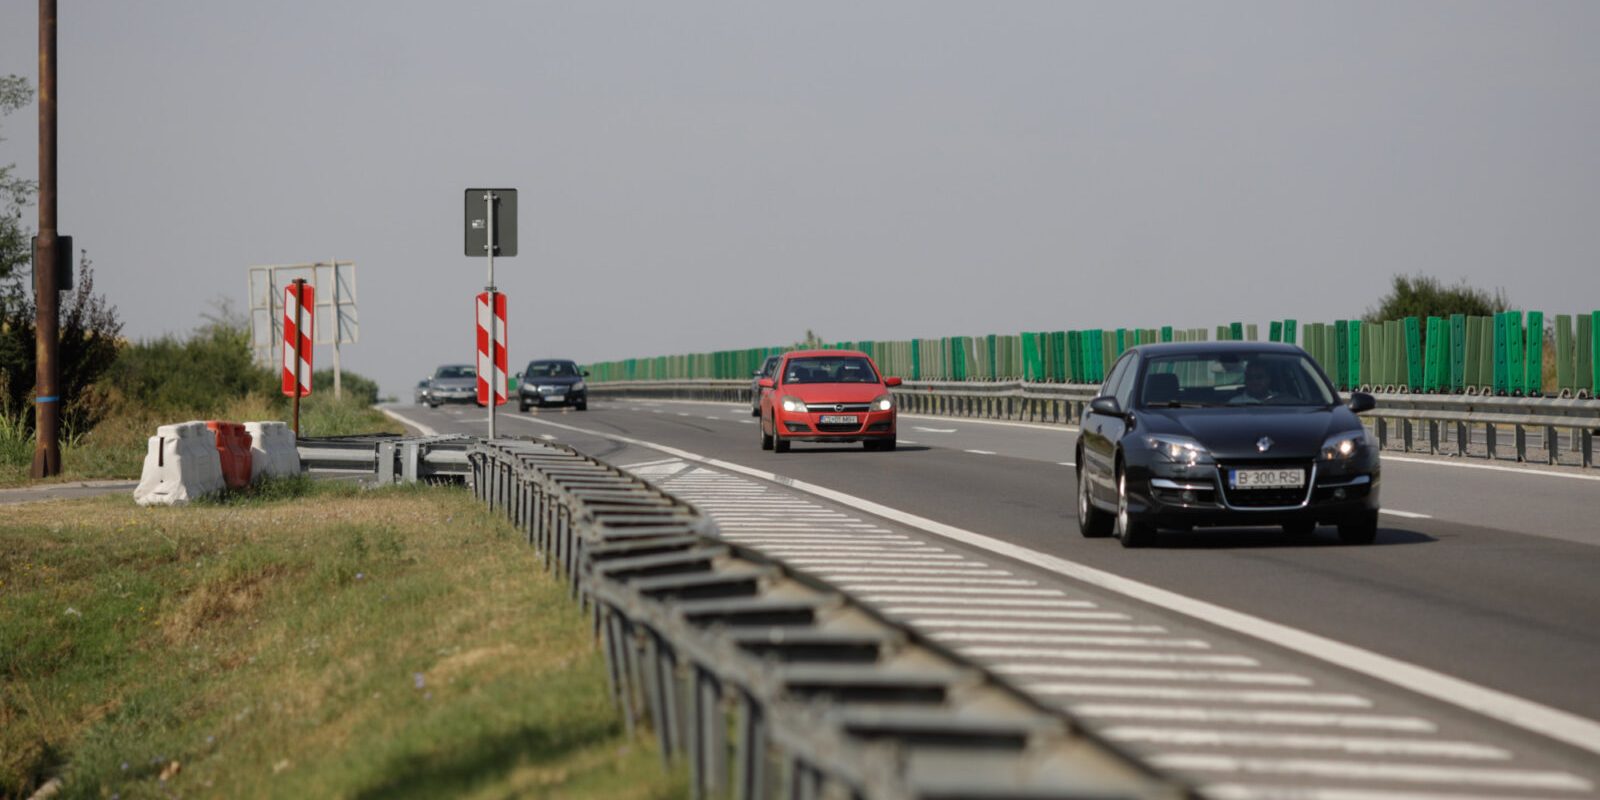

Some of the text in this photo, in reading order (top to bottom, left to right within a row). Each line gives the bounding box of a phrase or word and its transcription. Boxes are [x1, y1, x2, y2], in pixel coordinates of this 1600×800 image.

[1238, 470, 1301, 485] B 300 RSI
